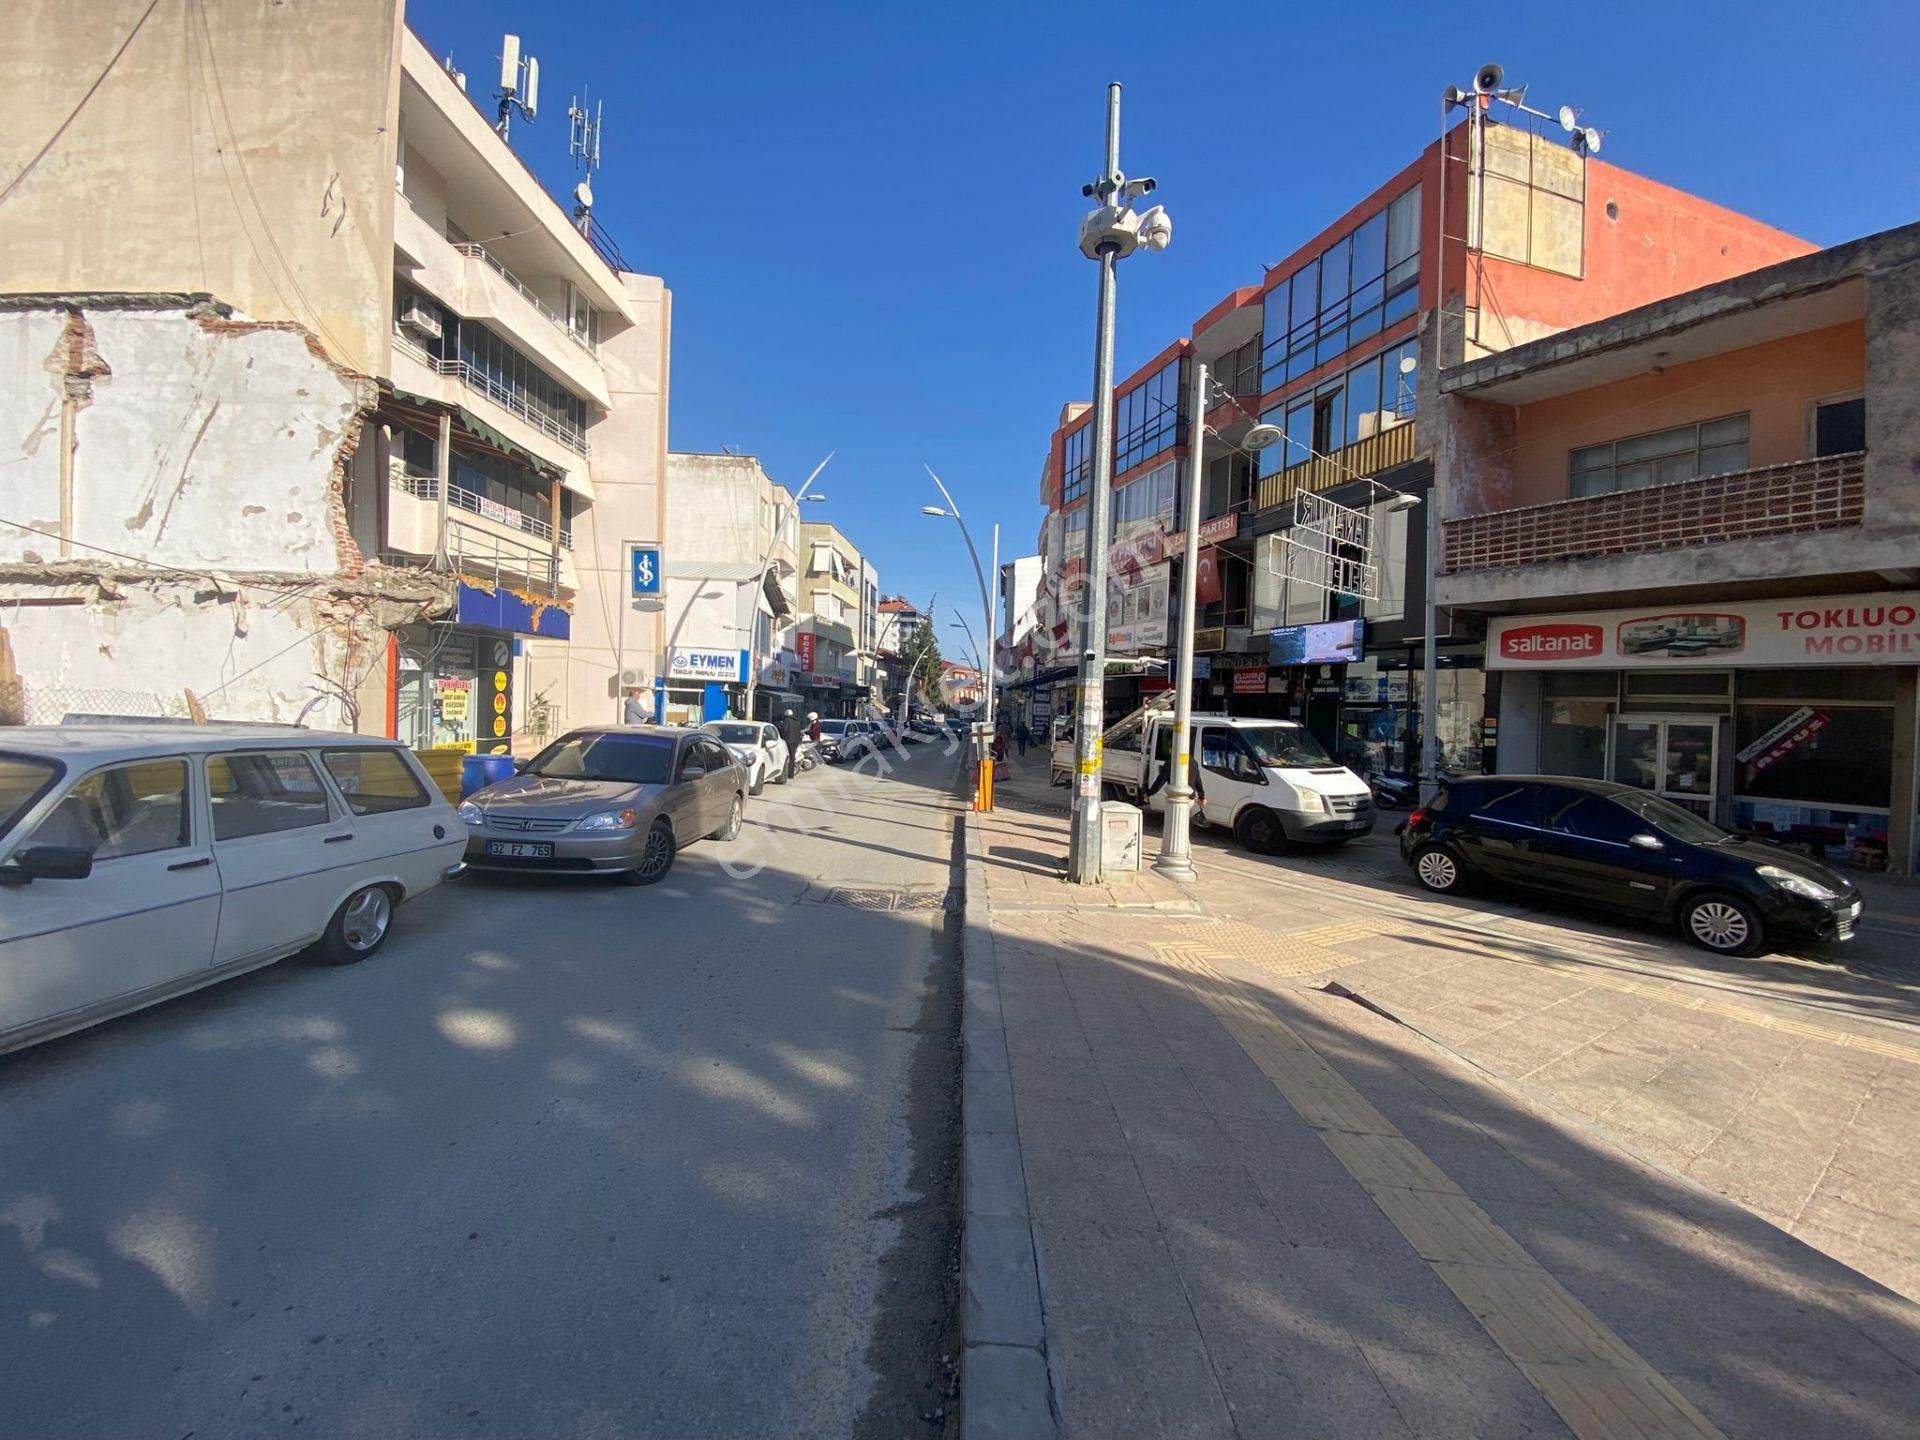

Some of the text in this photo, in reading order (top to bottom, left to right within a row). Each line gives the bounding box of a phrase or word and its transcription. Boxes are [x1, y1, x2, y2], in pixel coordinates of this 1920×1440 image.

[1776, 605, 1920, 631] TOKLUO
[802, 635, 810, 672] ECZANE
[1508, 633, 1594, 653] saltanat
[690, 654, 735, 668] EYMEN
[1759, 711, 1807, 746] dinarsu
[1757, 719, 1824, 769] ALTUS
[493, 843, 550, 856] 32 FZ 769
